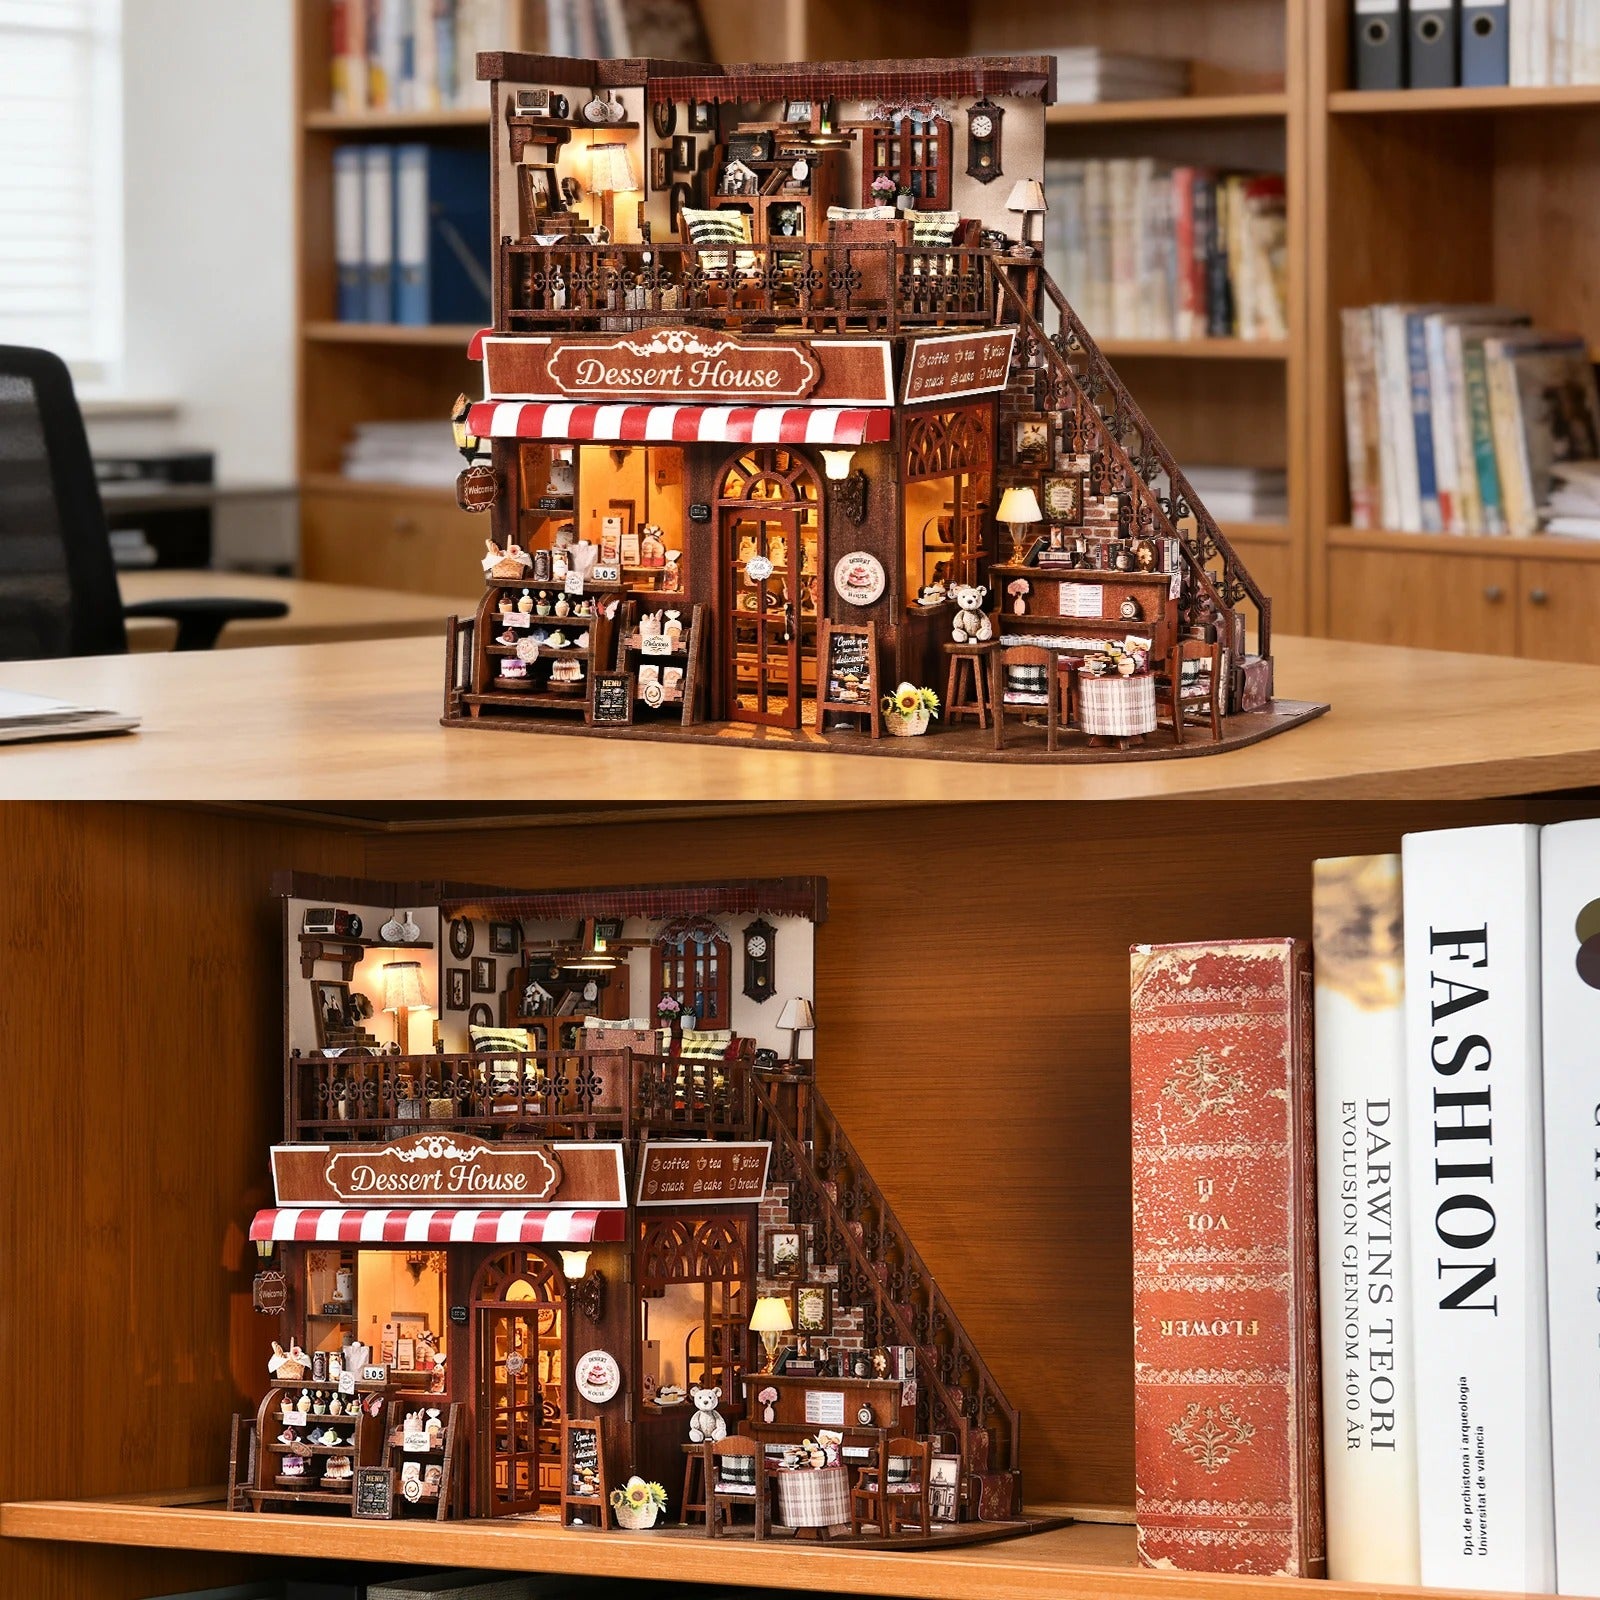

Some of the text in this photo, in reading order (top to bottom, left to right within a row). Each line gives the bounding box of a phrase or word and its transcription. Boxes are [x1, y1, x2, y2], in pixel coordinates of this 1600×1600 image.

[927, 345, 1005, 366] coffee tea juice
[576, 359, 781, 387] Dessert House
[924, 365, 1004, 388] snack cake bread
[468, 485, 494, 495] Welcome
[1429, 922, 1498, 1317] FASHION
[662, 1156, 760, 1170] coffee tea juice
[350, 1164, 528, 1192] Dessert House
[661, 1177, 759, 1192] snack cake bread
[1341, 1100, 1364, 1451] EVOLUSJON GJENNOM 400 ÅR
[1366, 1098, 1396, 1452] DARWINS TEORI
[262, 1289, 283, 1299] Welcome
[1159, 1320, 1260, 1337] FLOWER
[1474, 1425, 1488, 1556] Universitat de valencia
